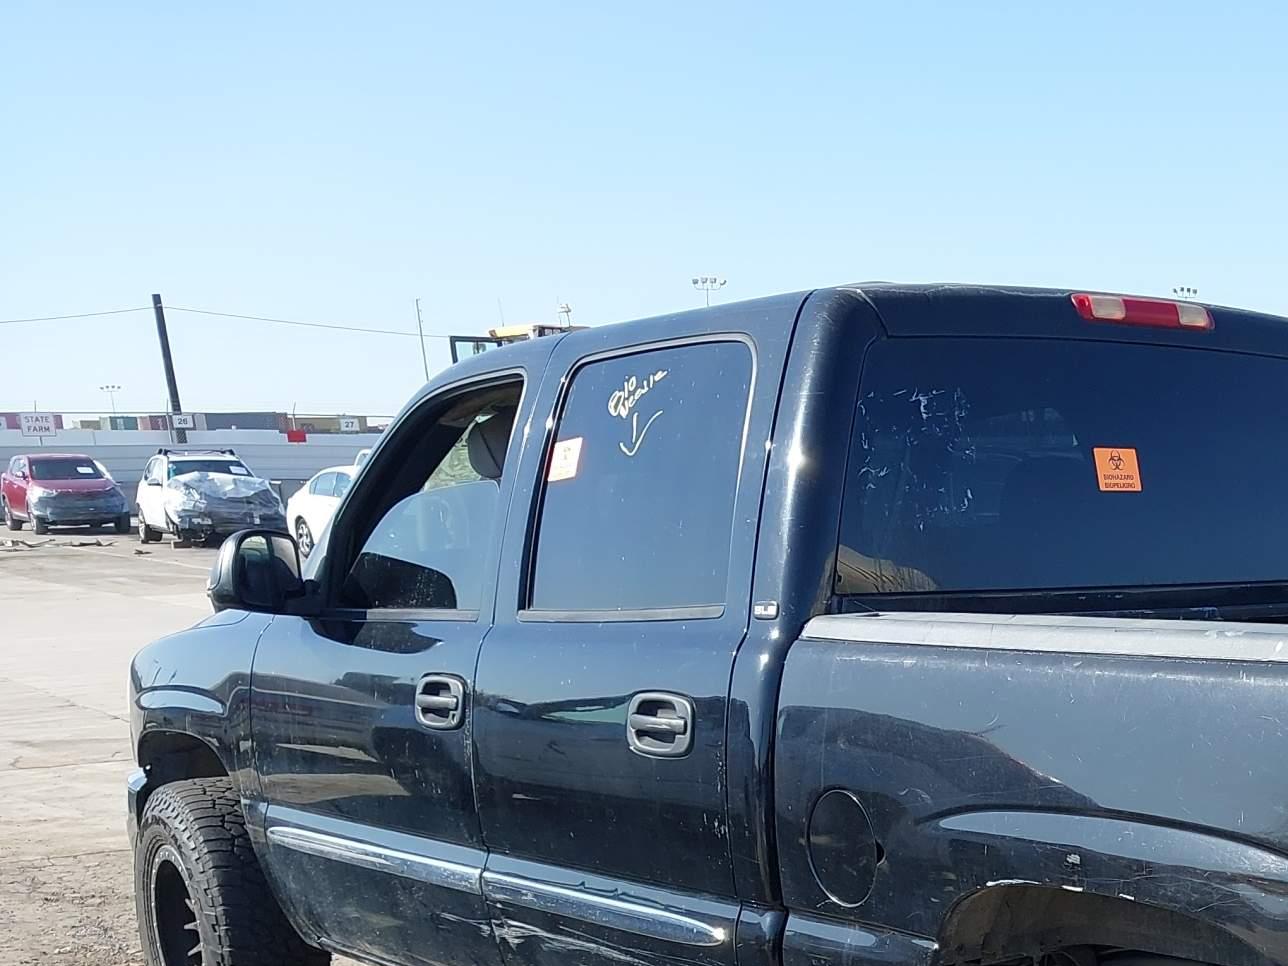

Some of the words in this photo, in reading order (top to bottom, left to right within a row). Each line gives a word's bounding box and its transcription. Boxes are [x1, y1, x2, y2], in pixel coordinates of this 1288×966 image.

[24, 415, 50, 423] STATE
[344, 420, 355, 428] 27
[27, 425, 51, 433] FARM
